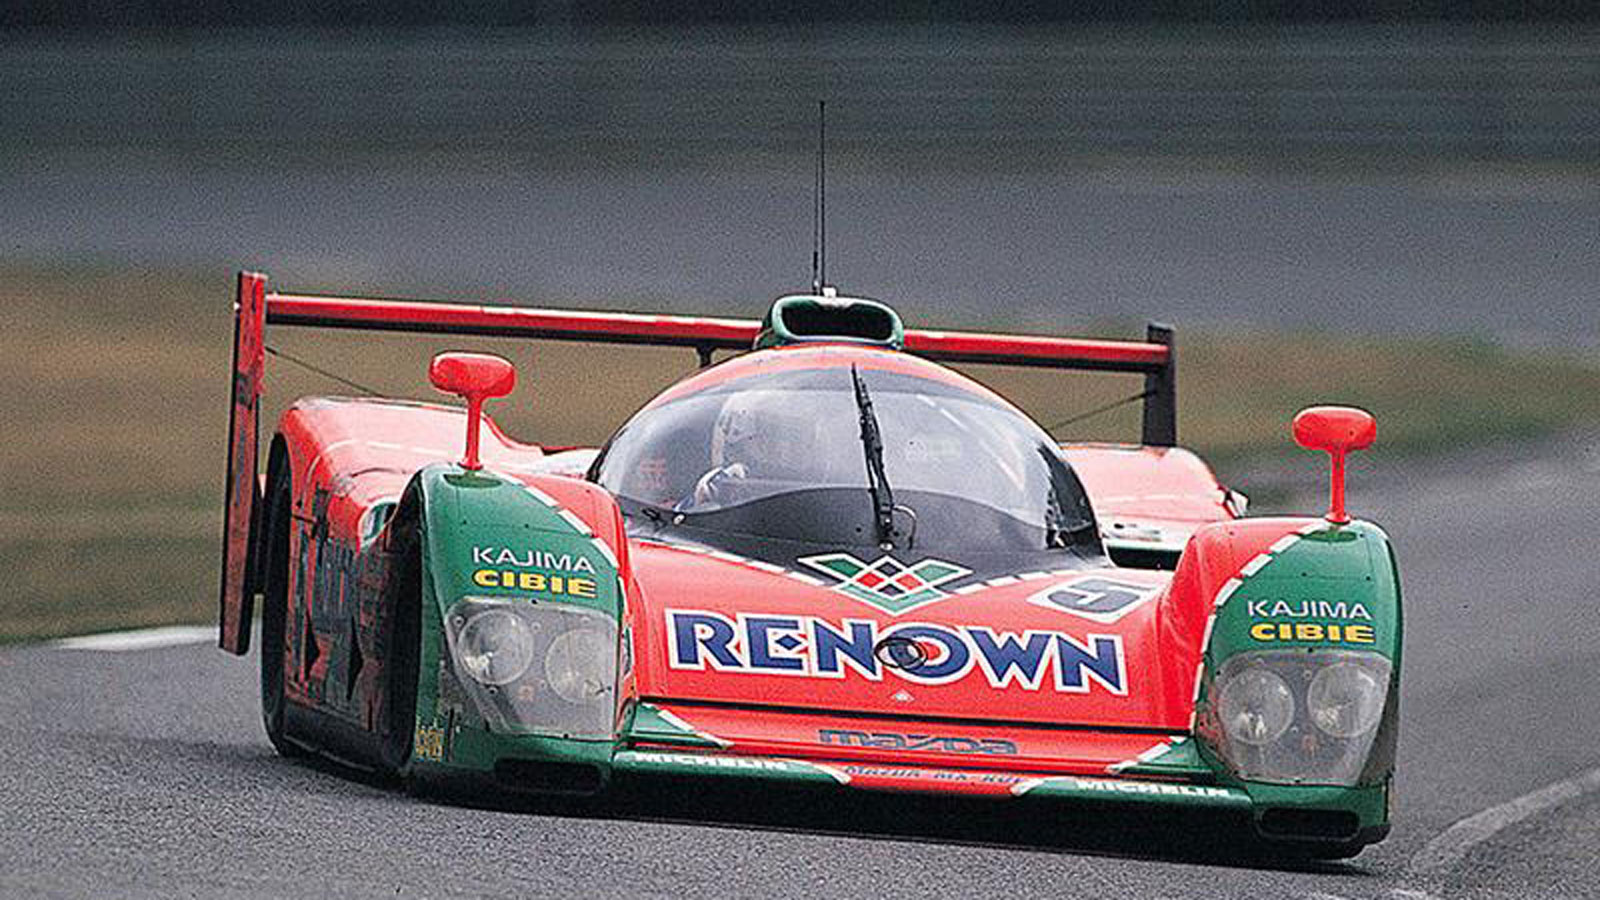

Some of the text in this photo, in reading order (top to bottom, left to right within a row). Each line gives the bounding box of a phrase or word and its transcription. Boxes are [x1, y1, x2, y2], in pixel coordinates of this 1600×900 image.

[472, 546, 595, 573] KAJIMA
[473, 569, 598, 598] CIBIE
[1247, 600, 1372, 620] KAJIMA
[1250, 622, 1376, 643] CIBIE
[667, 609, 1128, 696] RENOWN
